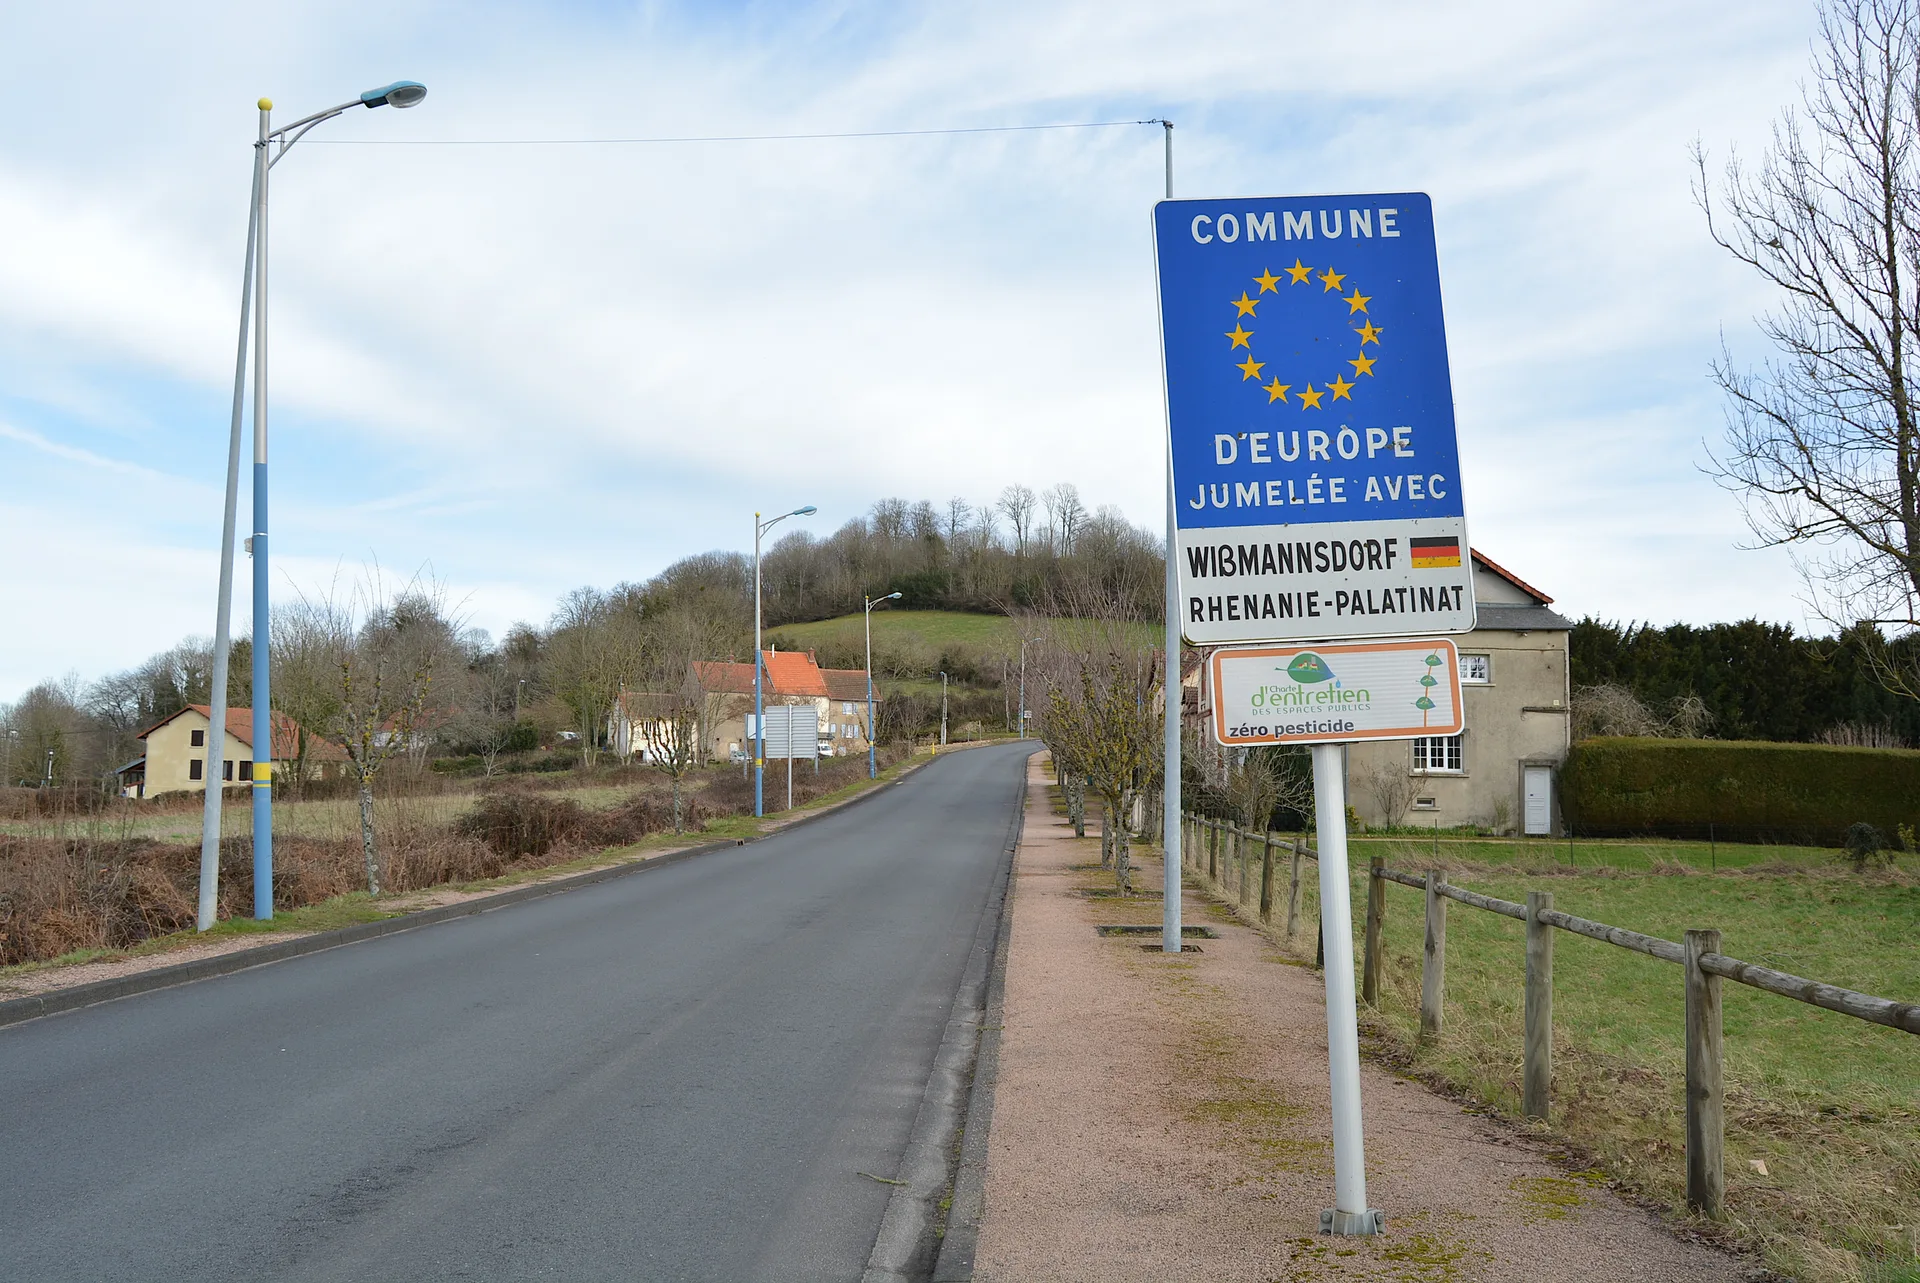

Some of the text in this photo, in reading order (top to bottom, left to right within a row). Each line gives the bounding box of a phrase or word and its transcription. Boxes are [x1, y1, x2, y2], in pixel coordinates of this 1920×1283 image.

[1191, 208, 1401, 244] COMMUNE
[1214, 426, 1415, 465] D'EUROPE
[1189, 473, 1447, 510] JUMELÉE AVEC
[1187, 538, 1398, 578] WIßMANNSDORF
[1190, 585, 1464, 623] RHENANIE-PALATINAT
[1251, 682, 1370, 707] d'entretien
[1269, 685, 1297, 693] Charte
[1252, 703, 1371, 716] DES ESPACES PUBLICS
[1229, 719, 1355, 738] zéro pesticide
